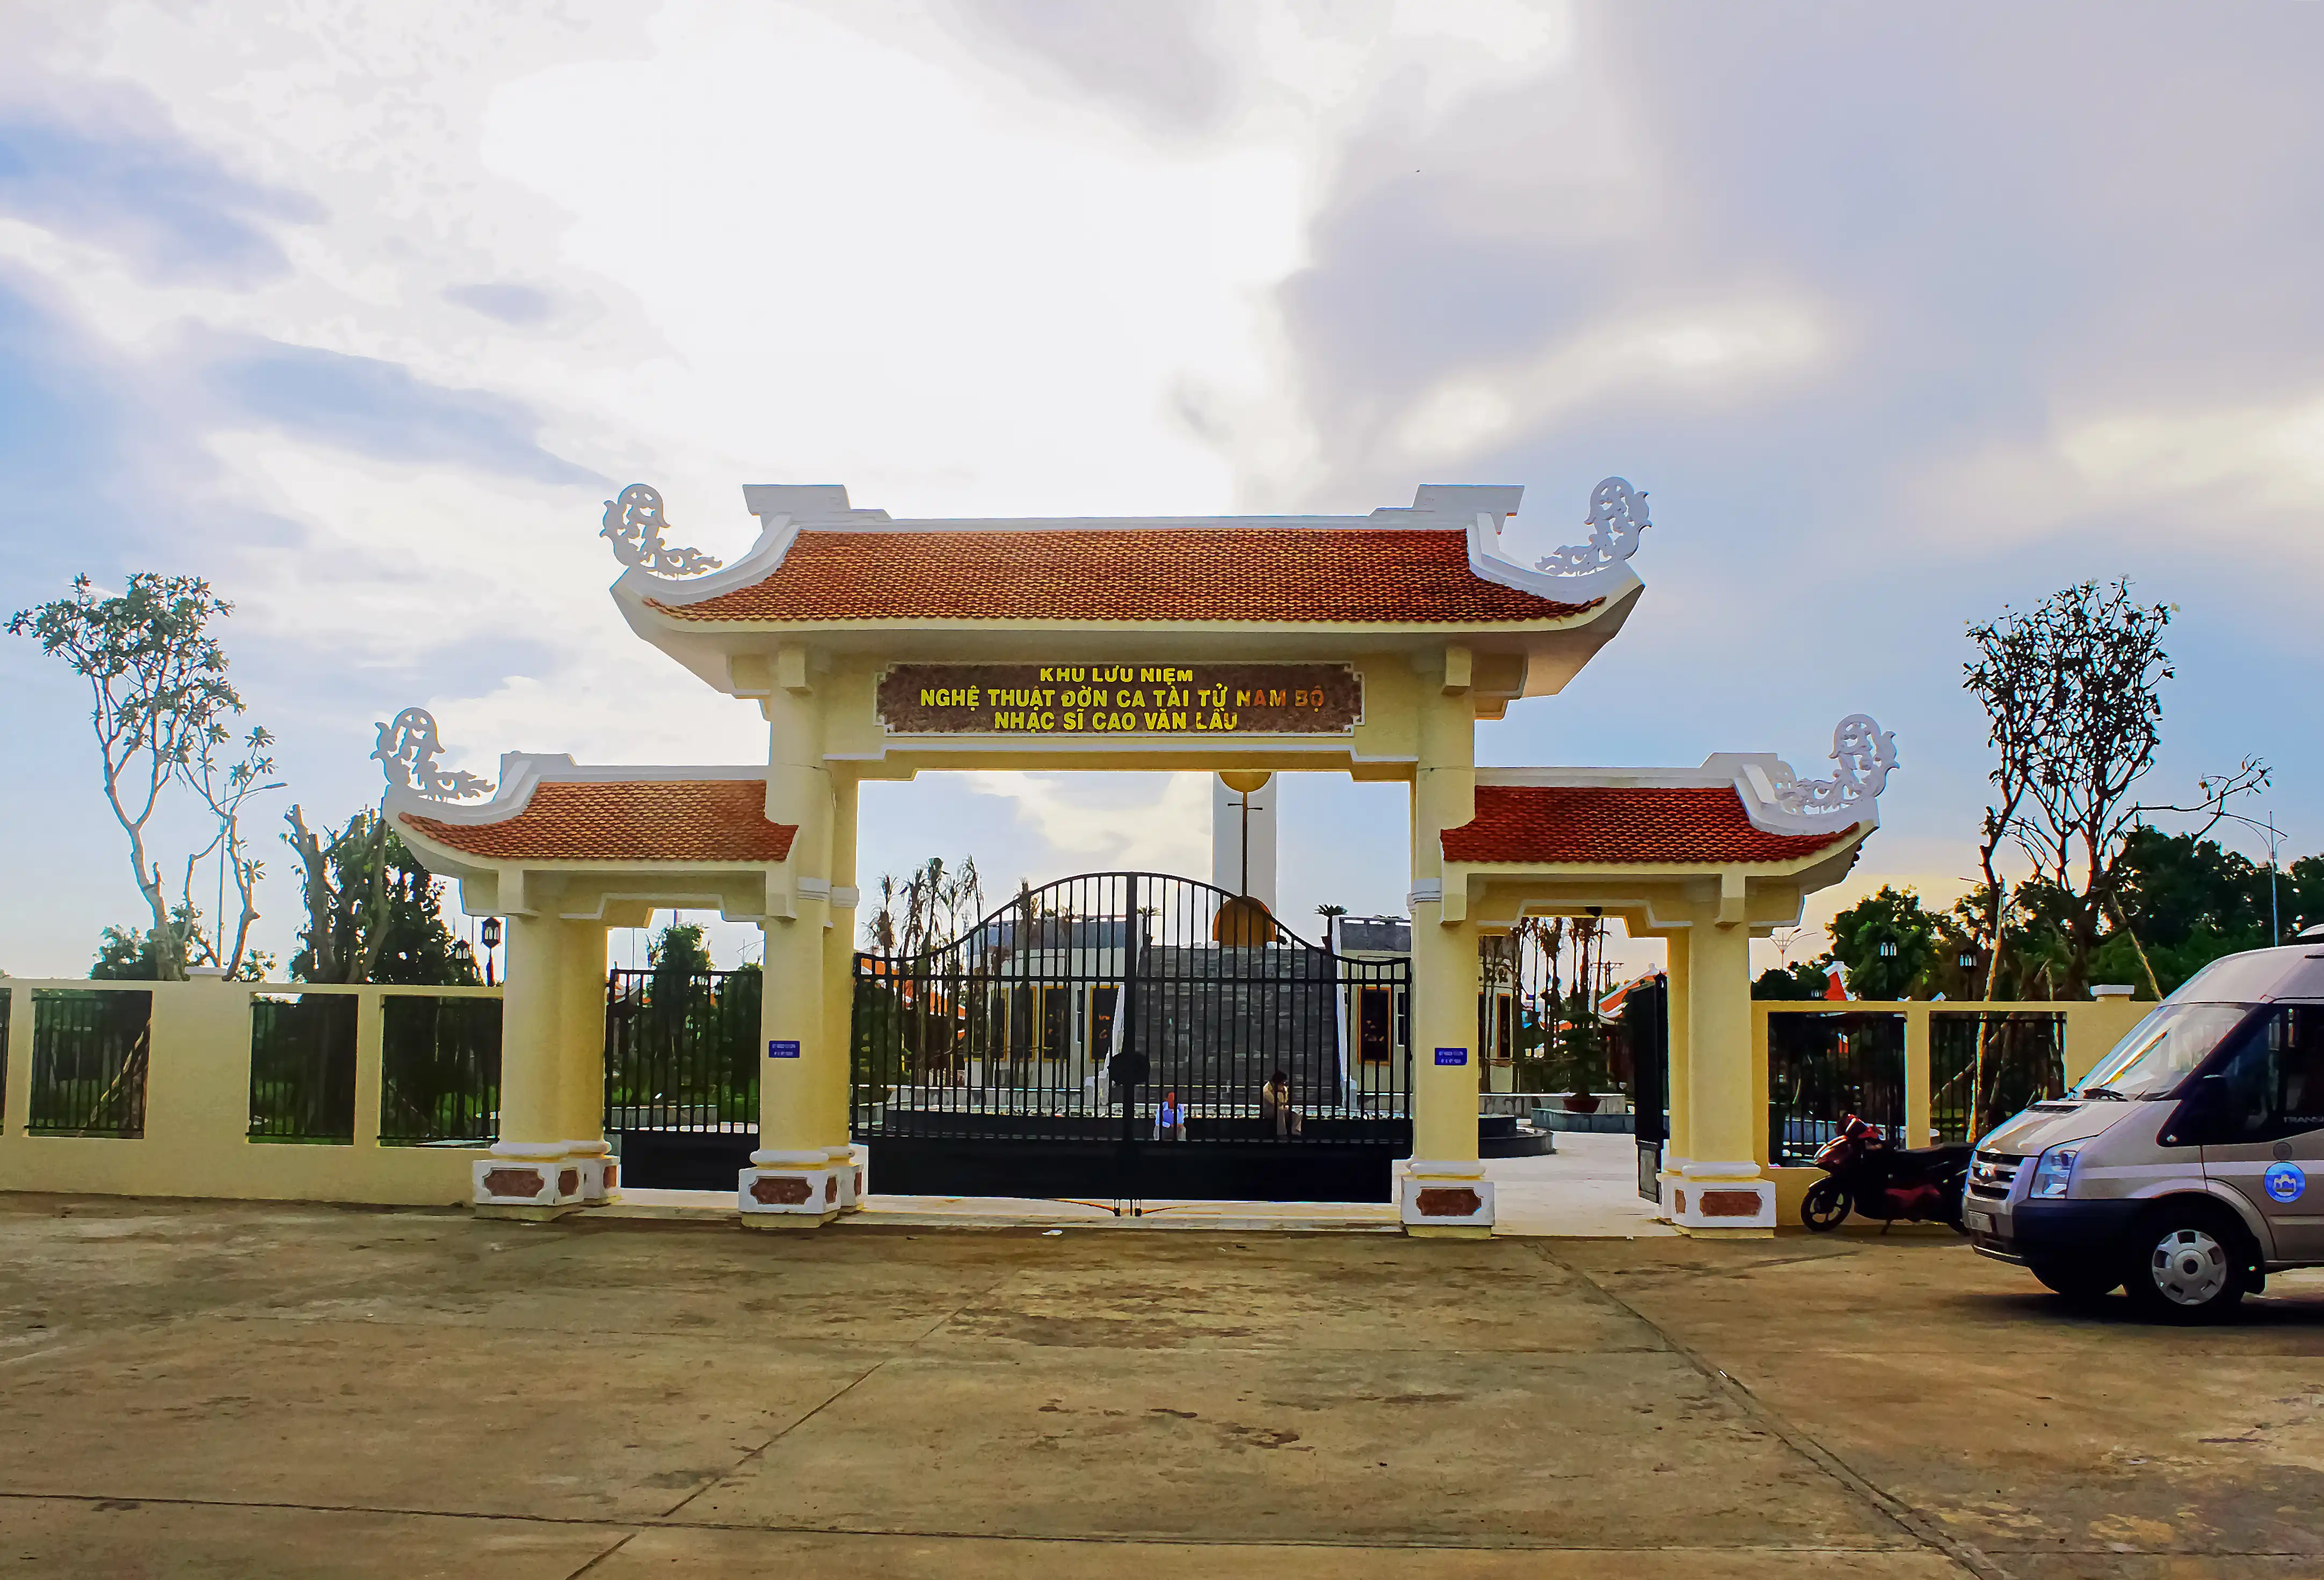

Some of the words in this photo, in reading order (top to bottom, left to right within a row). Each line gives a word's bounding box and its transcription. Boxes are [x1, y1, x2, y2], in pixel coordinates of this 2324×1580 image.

[1040, 668, 1085, 682] KHU
[1092, 665, 1133, 682] LƯU
[921, 685, 979, 711] NGHỆ
[987, 685, 1055, 710] THUẬT
[1116, 690, 1145, 707] CA
[1153, 686, 1188, 707] TÀI
[1197, 683, 1228, 707] TỬ
[1237, 689, 1286, 707] NAM
[1295, 685, 1324, 712] BỘ
[995, 711, 1054, 733] NHẠC
[1063, 708, 1084, 730] SĨ
[1092, 712, 1136, 730] CAO
[1144, 708, 1186, 730] VĂN
[1196, 707, 1237, 730] LẦU
